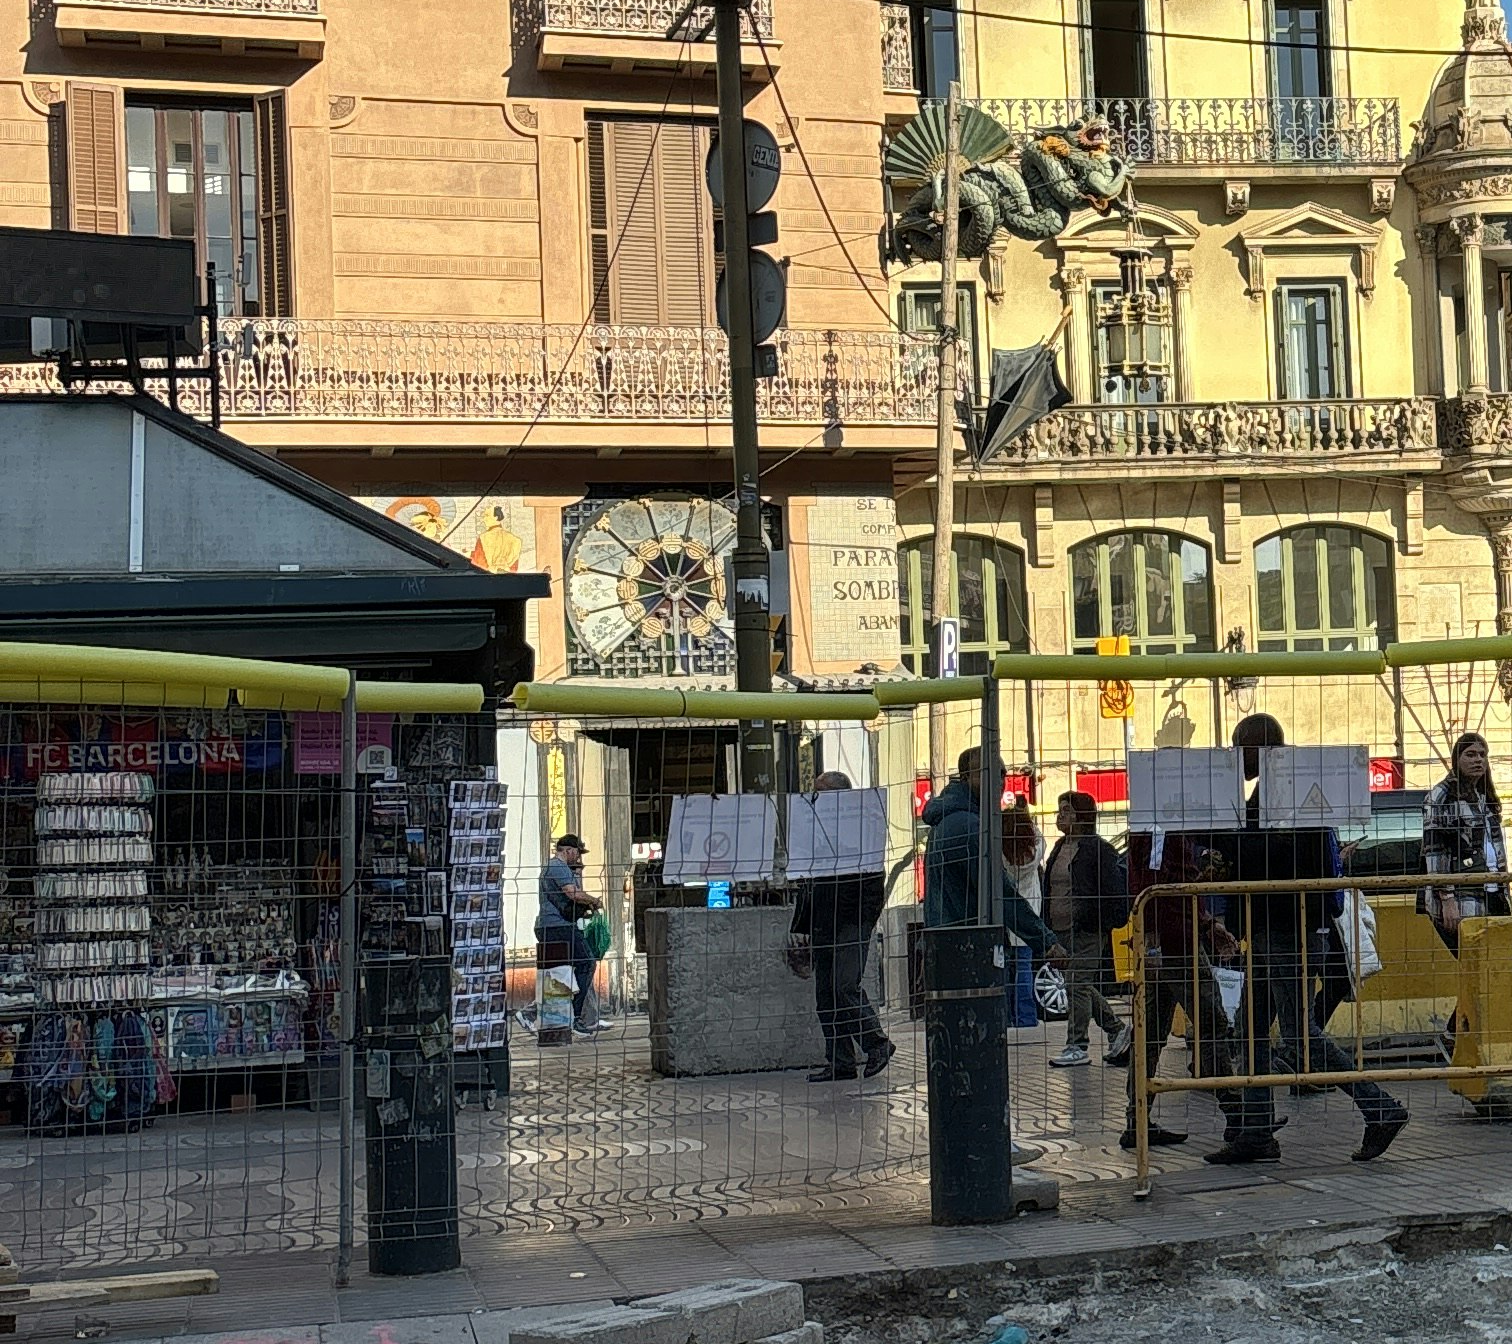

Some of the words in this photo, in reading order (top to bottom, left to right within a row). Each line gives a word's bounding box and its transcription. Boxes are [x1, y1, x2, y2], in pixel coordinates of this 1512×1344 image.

[857, 499, 876, 511] SE
[27, 743, 61, 768] FC
[68, 740, 241, 768] BARCELONA
